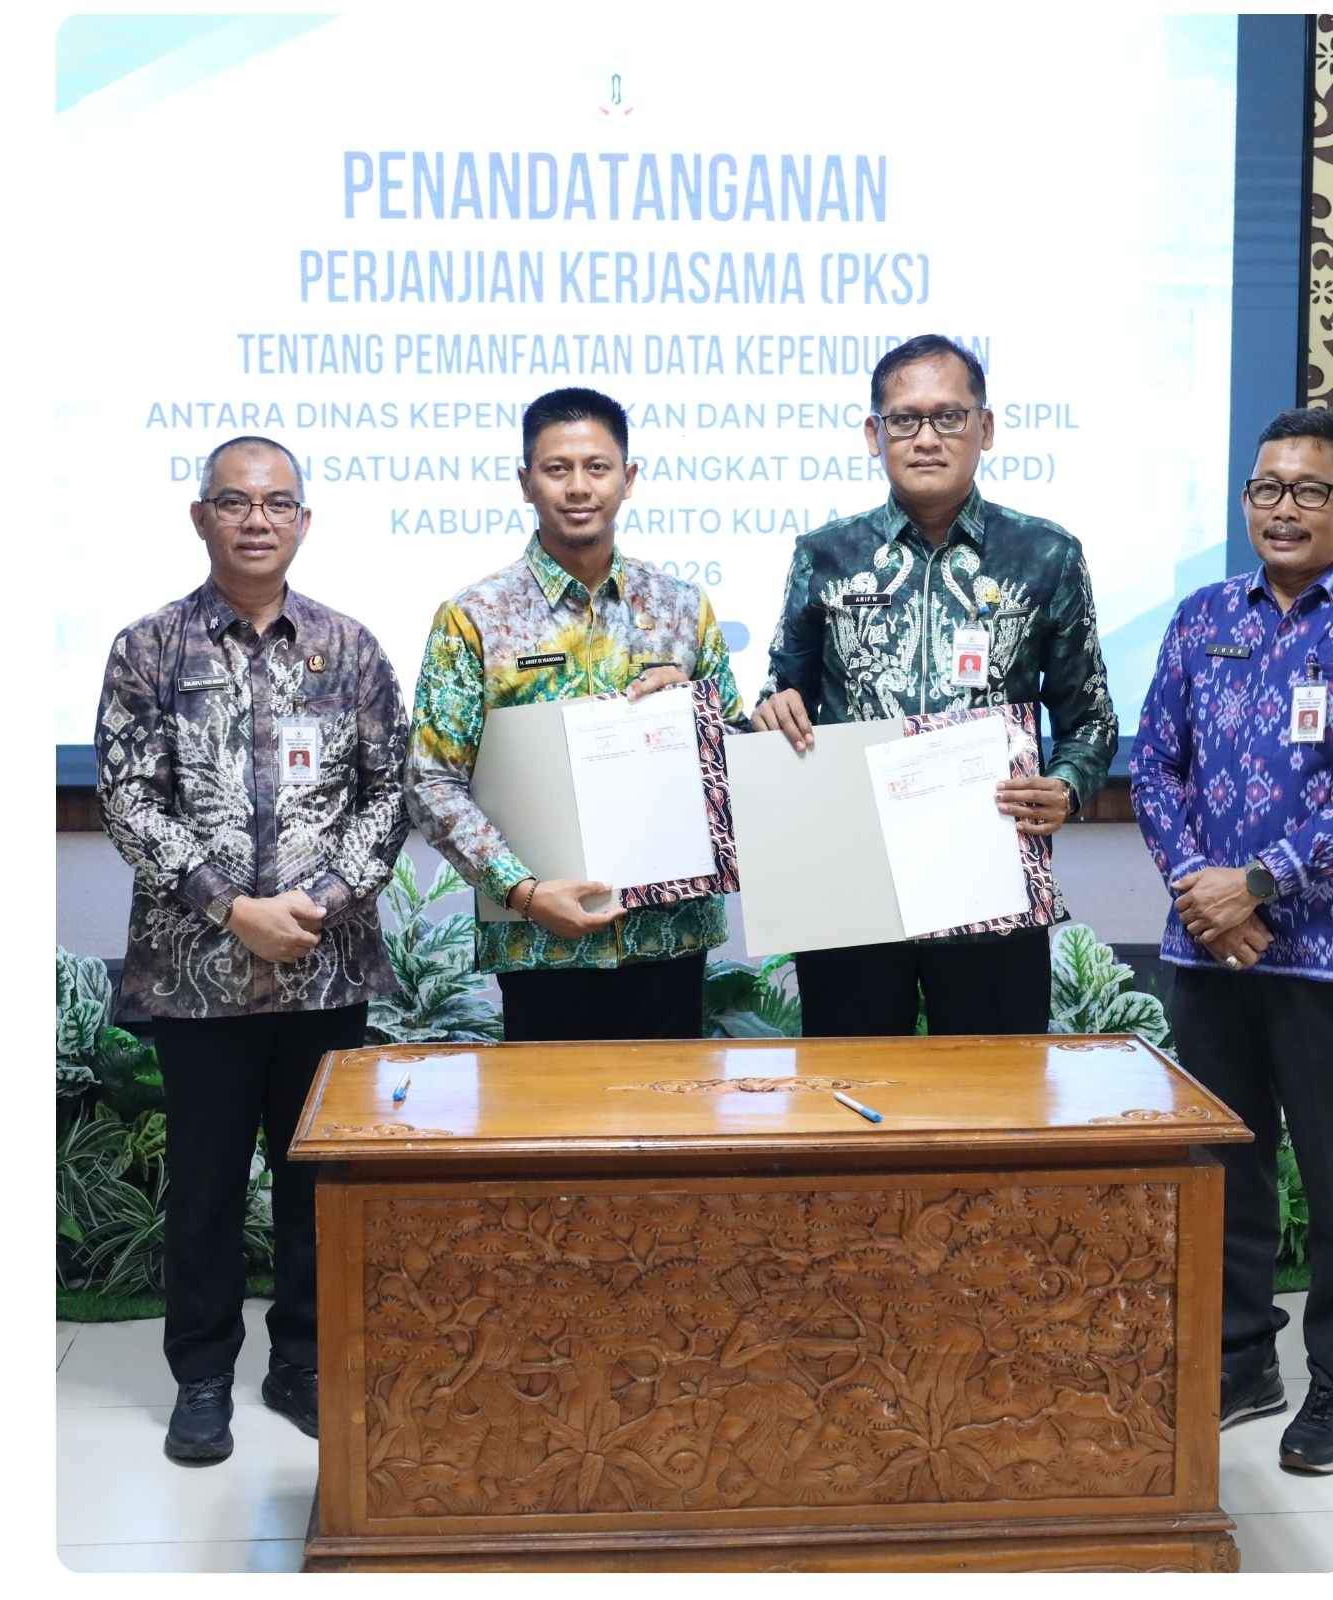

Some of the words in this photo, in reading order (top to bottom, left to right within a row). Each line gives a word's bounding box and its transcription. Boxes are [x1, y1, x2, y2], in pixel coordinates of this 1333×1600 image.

[343, 150, 887, 222] PENANDATANGAN
[300, 250, 545, 304] PERJANJIAN
[560, 250, 805, 304] KERJASAMA
[820, 252, 930, 304] (PKS)
[237, 334, 383, 374] TENTANG
[395, 334, 632, 374] PEMANFAATAN
[645, 334, 724, 374] DATA
[146, 402, 285, 428] ANTARA
[297, 402, 399, 428] DINAS
[698, 402, 765, 428] DAN
[1004, 403, 1079, 428] SIPIL
[324, 456, 459, 481] SATUAN
